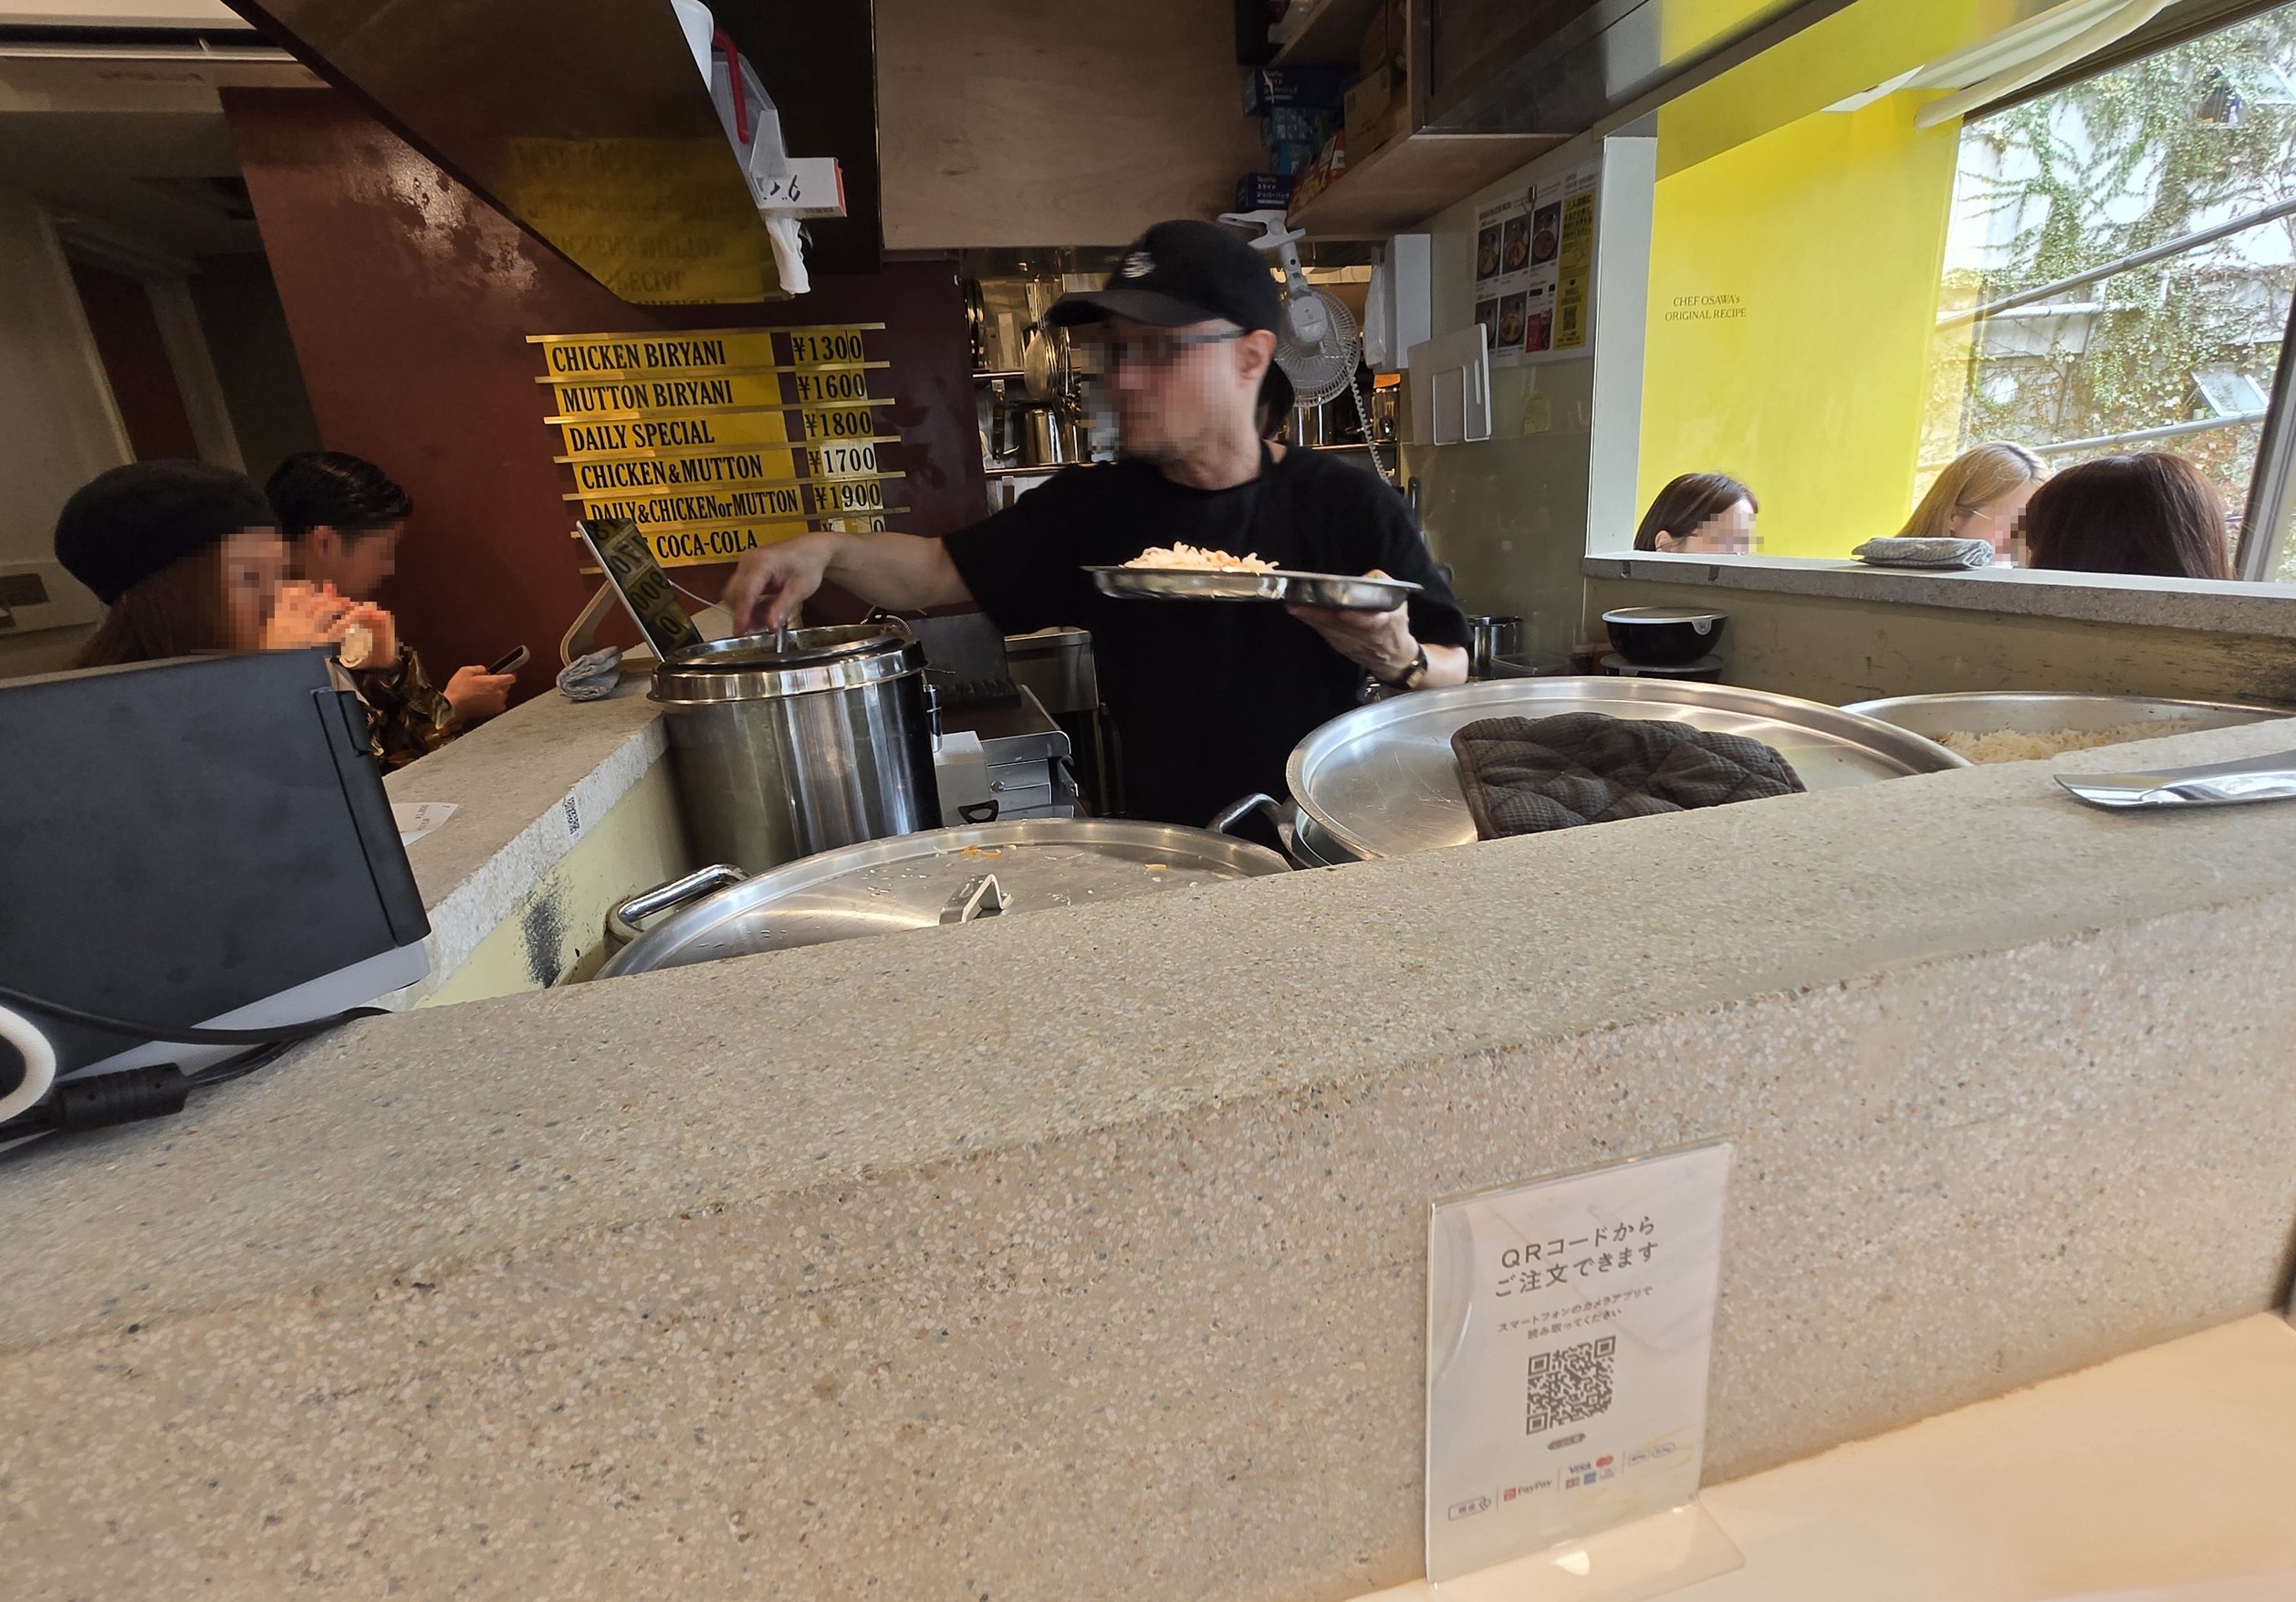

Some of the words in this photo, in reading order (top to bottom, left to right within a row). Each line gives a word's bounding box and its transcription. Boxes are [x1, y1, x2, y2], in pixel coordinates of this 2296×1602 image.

[1665, 310, 1711, 321] ORIGINAL
[1713, 308, 1747, 319] RECIPE
[1673, 296, 1699, 307] CHEF
[1701, 294, 1740, 306] OSAWA's
[551, 343, 642, 373] CHICKEN
[646, 340, 727, 369] BIRYANI
[792, 334, 862, 361] ¥1300
[561, 382, 650, 414] MUTTON
[654, 379, 734, 408] BIRYANI
[798, 372, 866, 400] ¥1600
[569, 424, 630, 453] DAILY
[631, 420, 715, 449] SPECIAL
[805, 411, 873, 438] ¥1800
[580, 455, 764, 490] CHICKEN&MUTTON
[809, 446, 875, 475] ¥1700
[815, 483, 882, 510] ¥1900
[656, 528, 759, 560] COCA-COLA
[1500, 1216, 1655, 1270] QRコードから
[1495, 1241, 1659, 1297] ご注文できます
